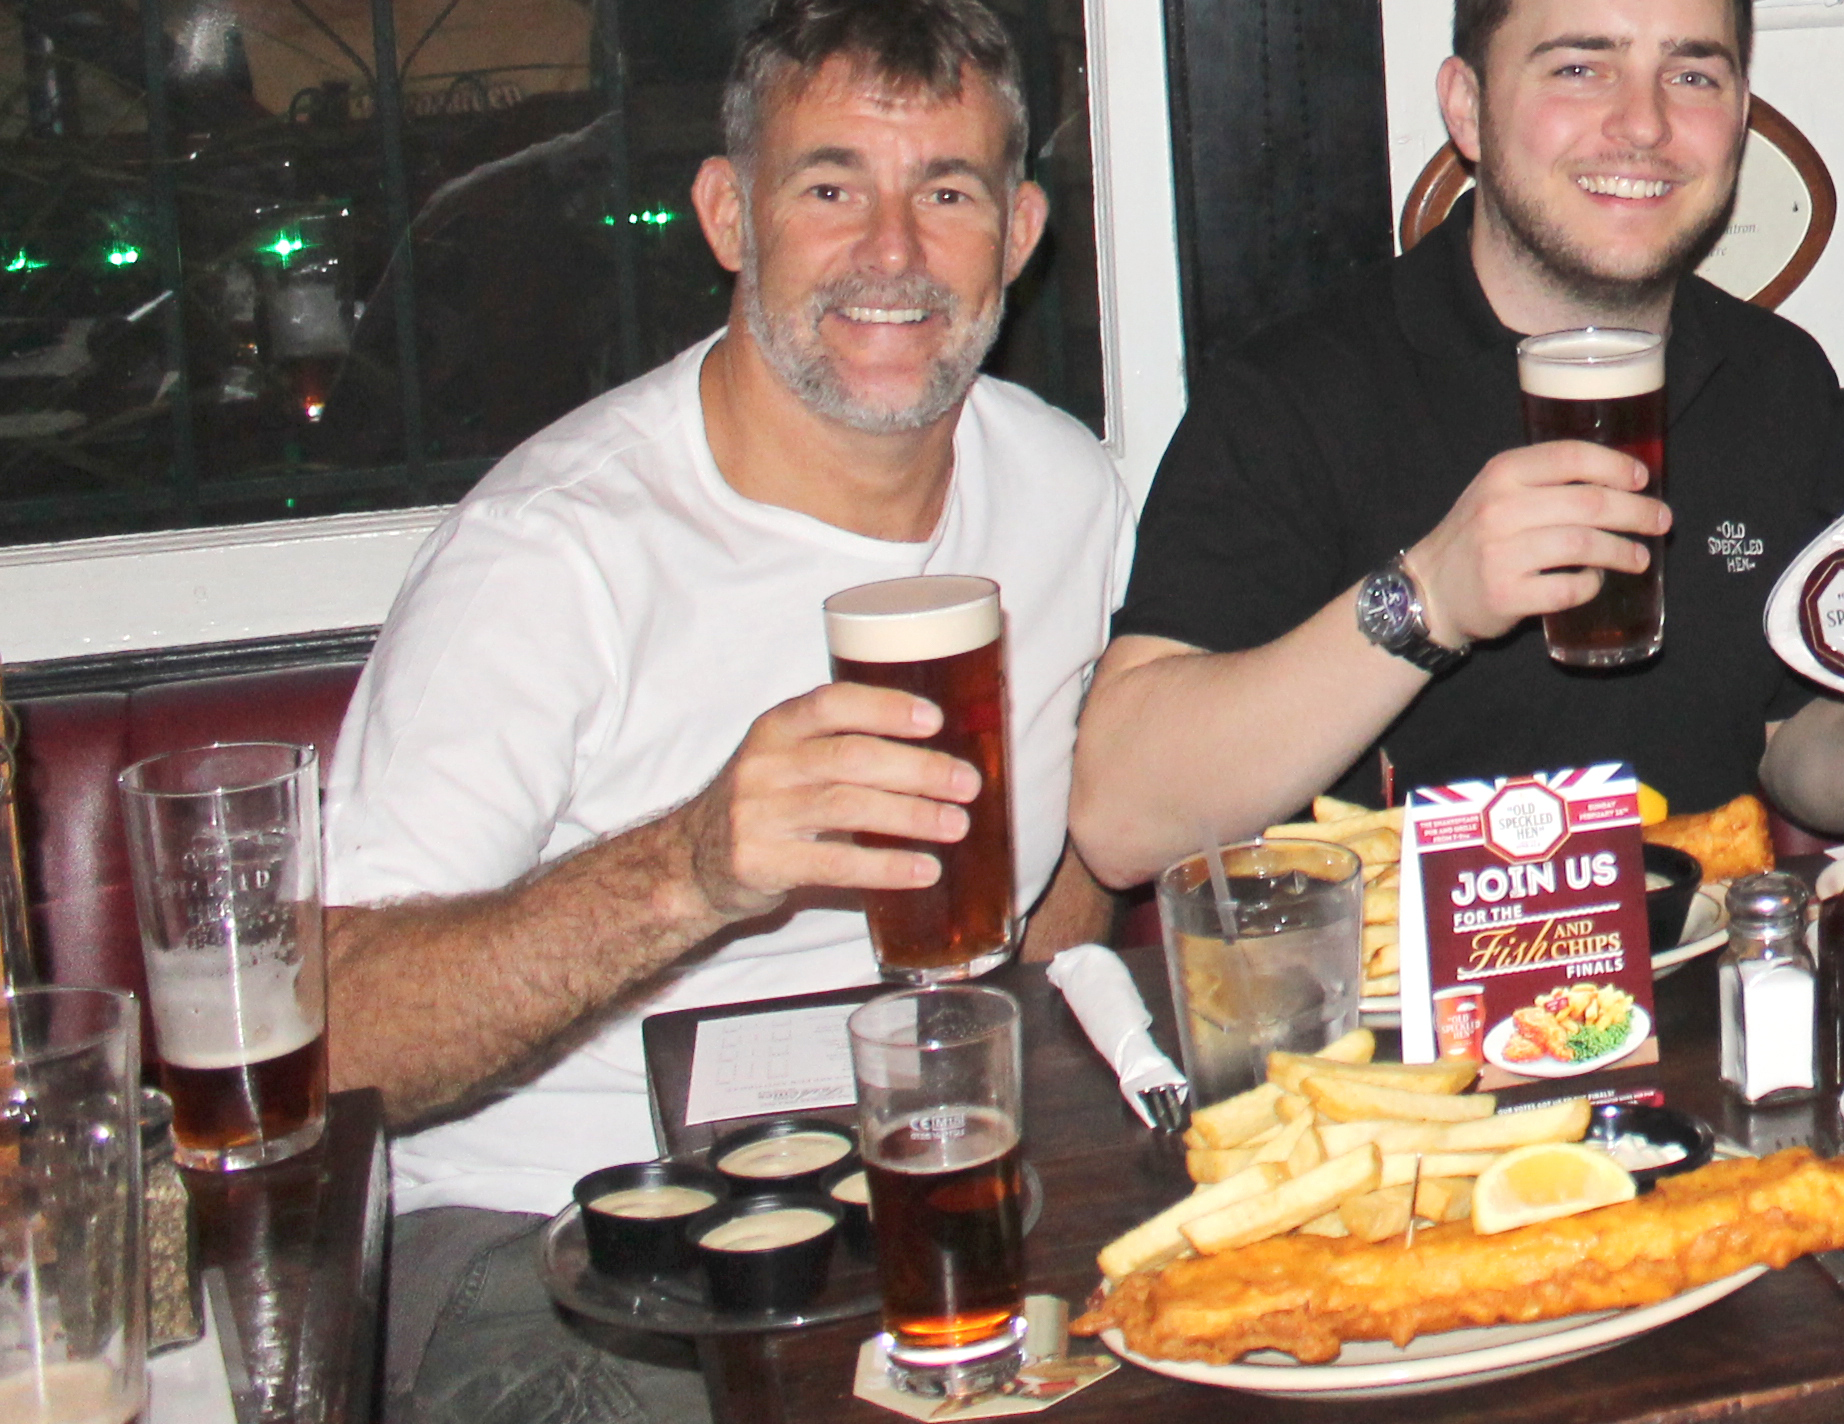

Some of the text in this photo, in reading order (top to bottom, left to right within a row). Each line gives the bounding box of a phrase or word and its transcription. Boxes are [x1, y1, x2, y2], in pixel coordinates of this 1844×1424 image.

[1708, 537, 1763, 555] SPECKLED
[1499, 812, 1553, 829] SPECKLED
[1451, 851, 1619, 907] JOIN US
[1453, 904, 1523, 927] FOR THE
[1458, 918, 1593, 977] Fish AND
[1551, 932, 1622, 960] CHIPS
[1566, 958, 1625, 979] FINALS
